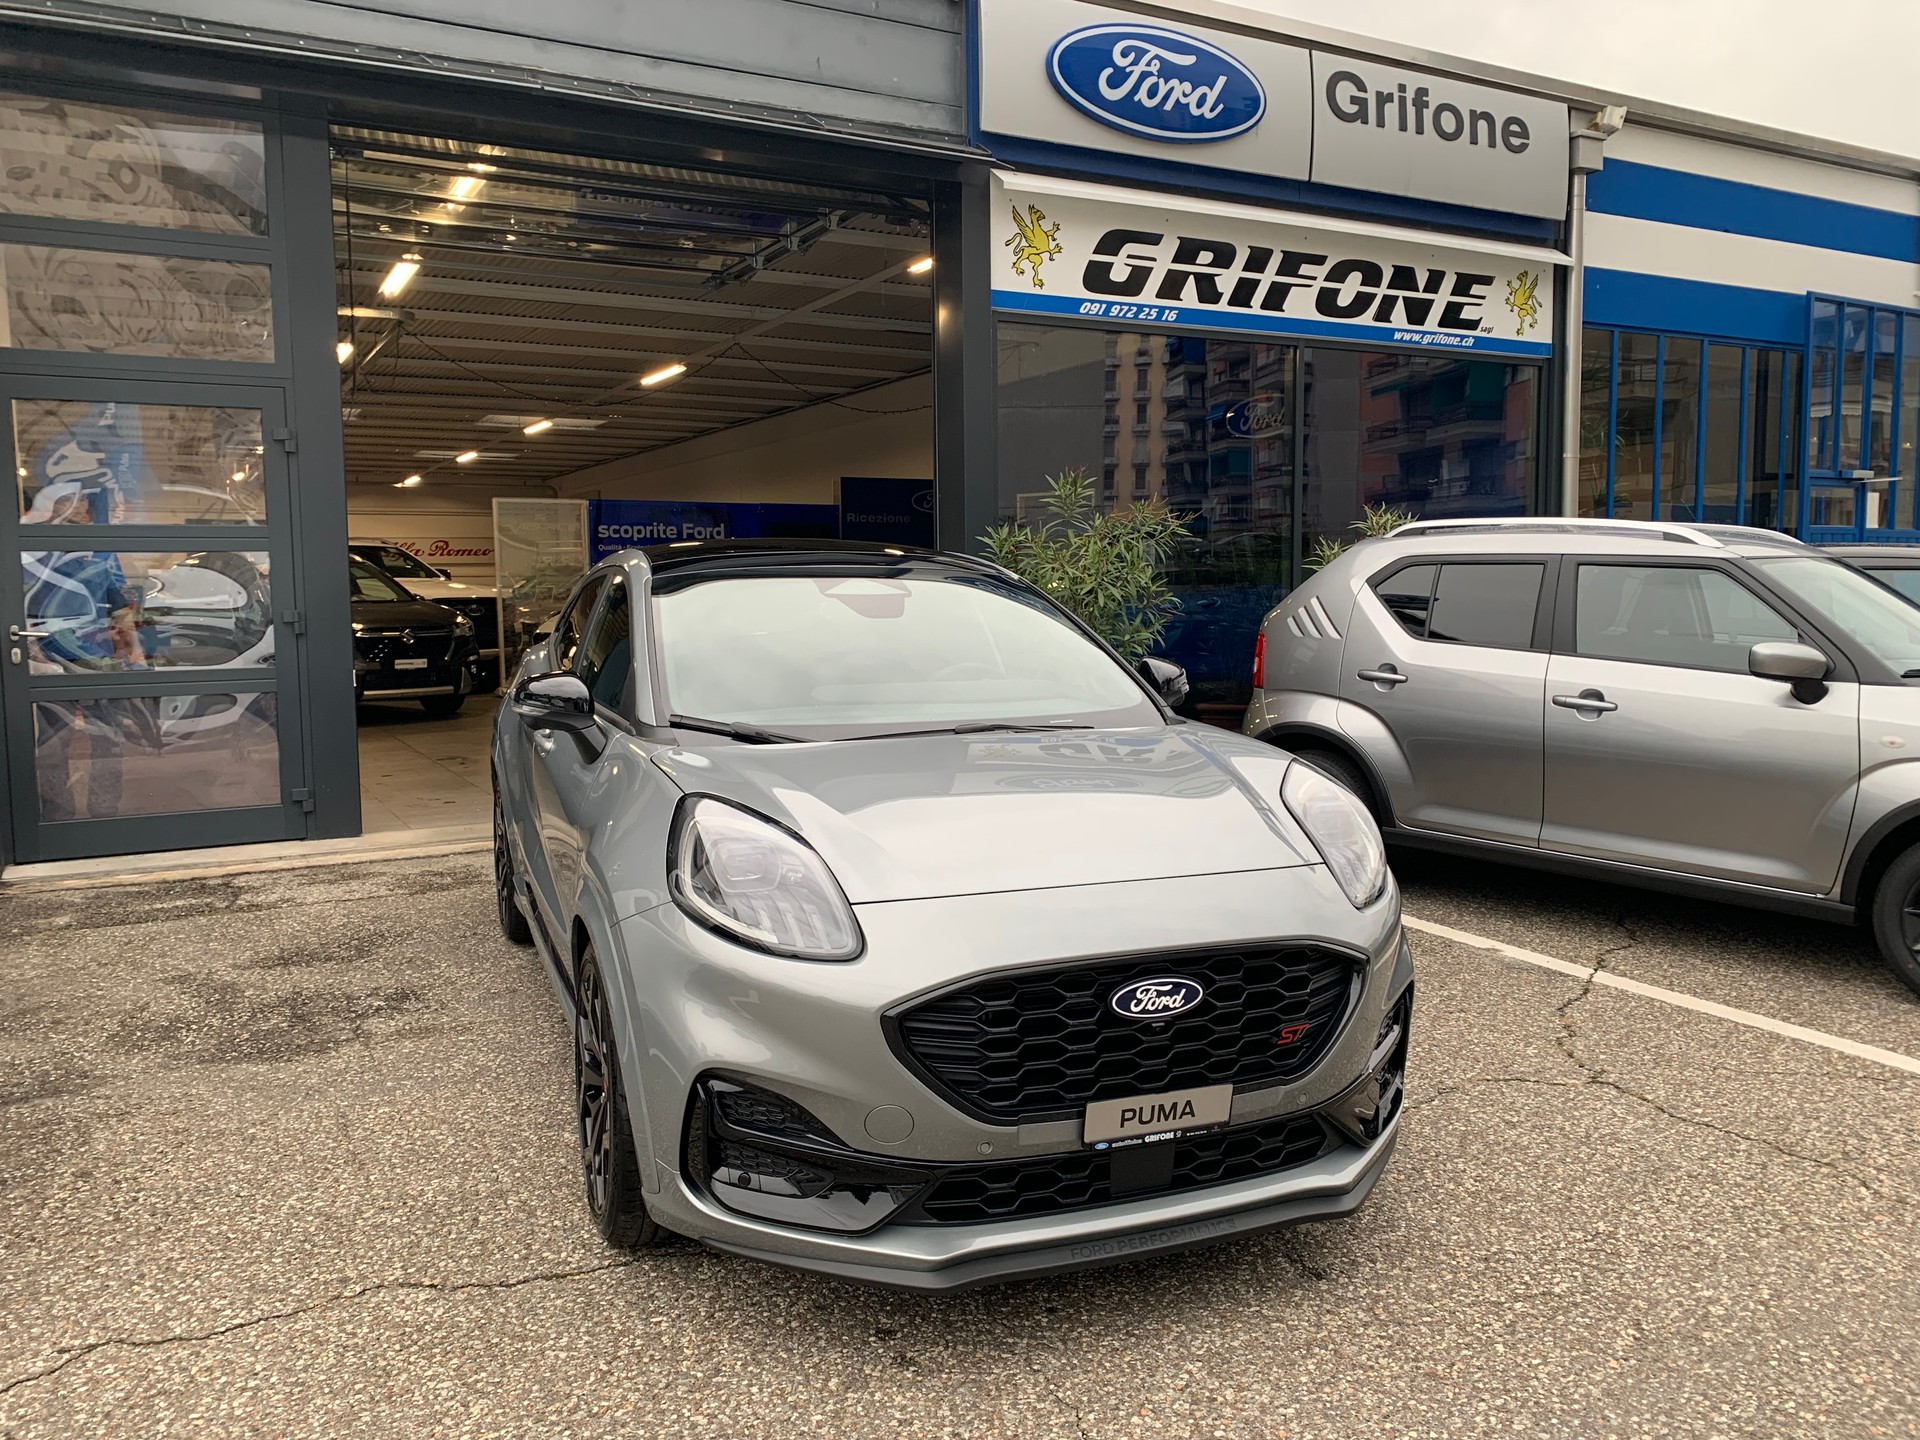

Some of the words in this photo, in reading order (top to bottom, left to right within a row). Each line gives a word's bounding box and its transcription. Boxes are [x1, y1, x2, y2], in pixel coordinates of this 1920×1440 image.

[1098, 39, 1228, 119] Ford
[1325, 70, 1531, 154] Grifone
[1082, 228, 1496, 332] GRIFONE
[1079, 302, 1107, 315] 091
[1109, 304, 1138, 318] 972
[1138, 307, 1160, 320] 25
[1161, 309, 1179, 322] 16
[1393, 331, 1475, 347] www.grifone.ch
[1240, 400, 1285, 431] Ford
[846, 512, 911, 523] Ricezione
[597, 521, 678, 542] scoprite
[682, 522, 726, 540] Ford
[427, 539, 495, 557] Romeo
[1129, 983, 1187, 1013] Ford
[1277, 1023, 1310, 1045] ST
[1119, 1099, 1196, 1129] PUMA
[1070, 1243, 1114, 1260] FORD
